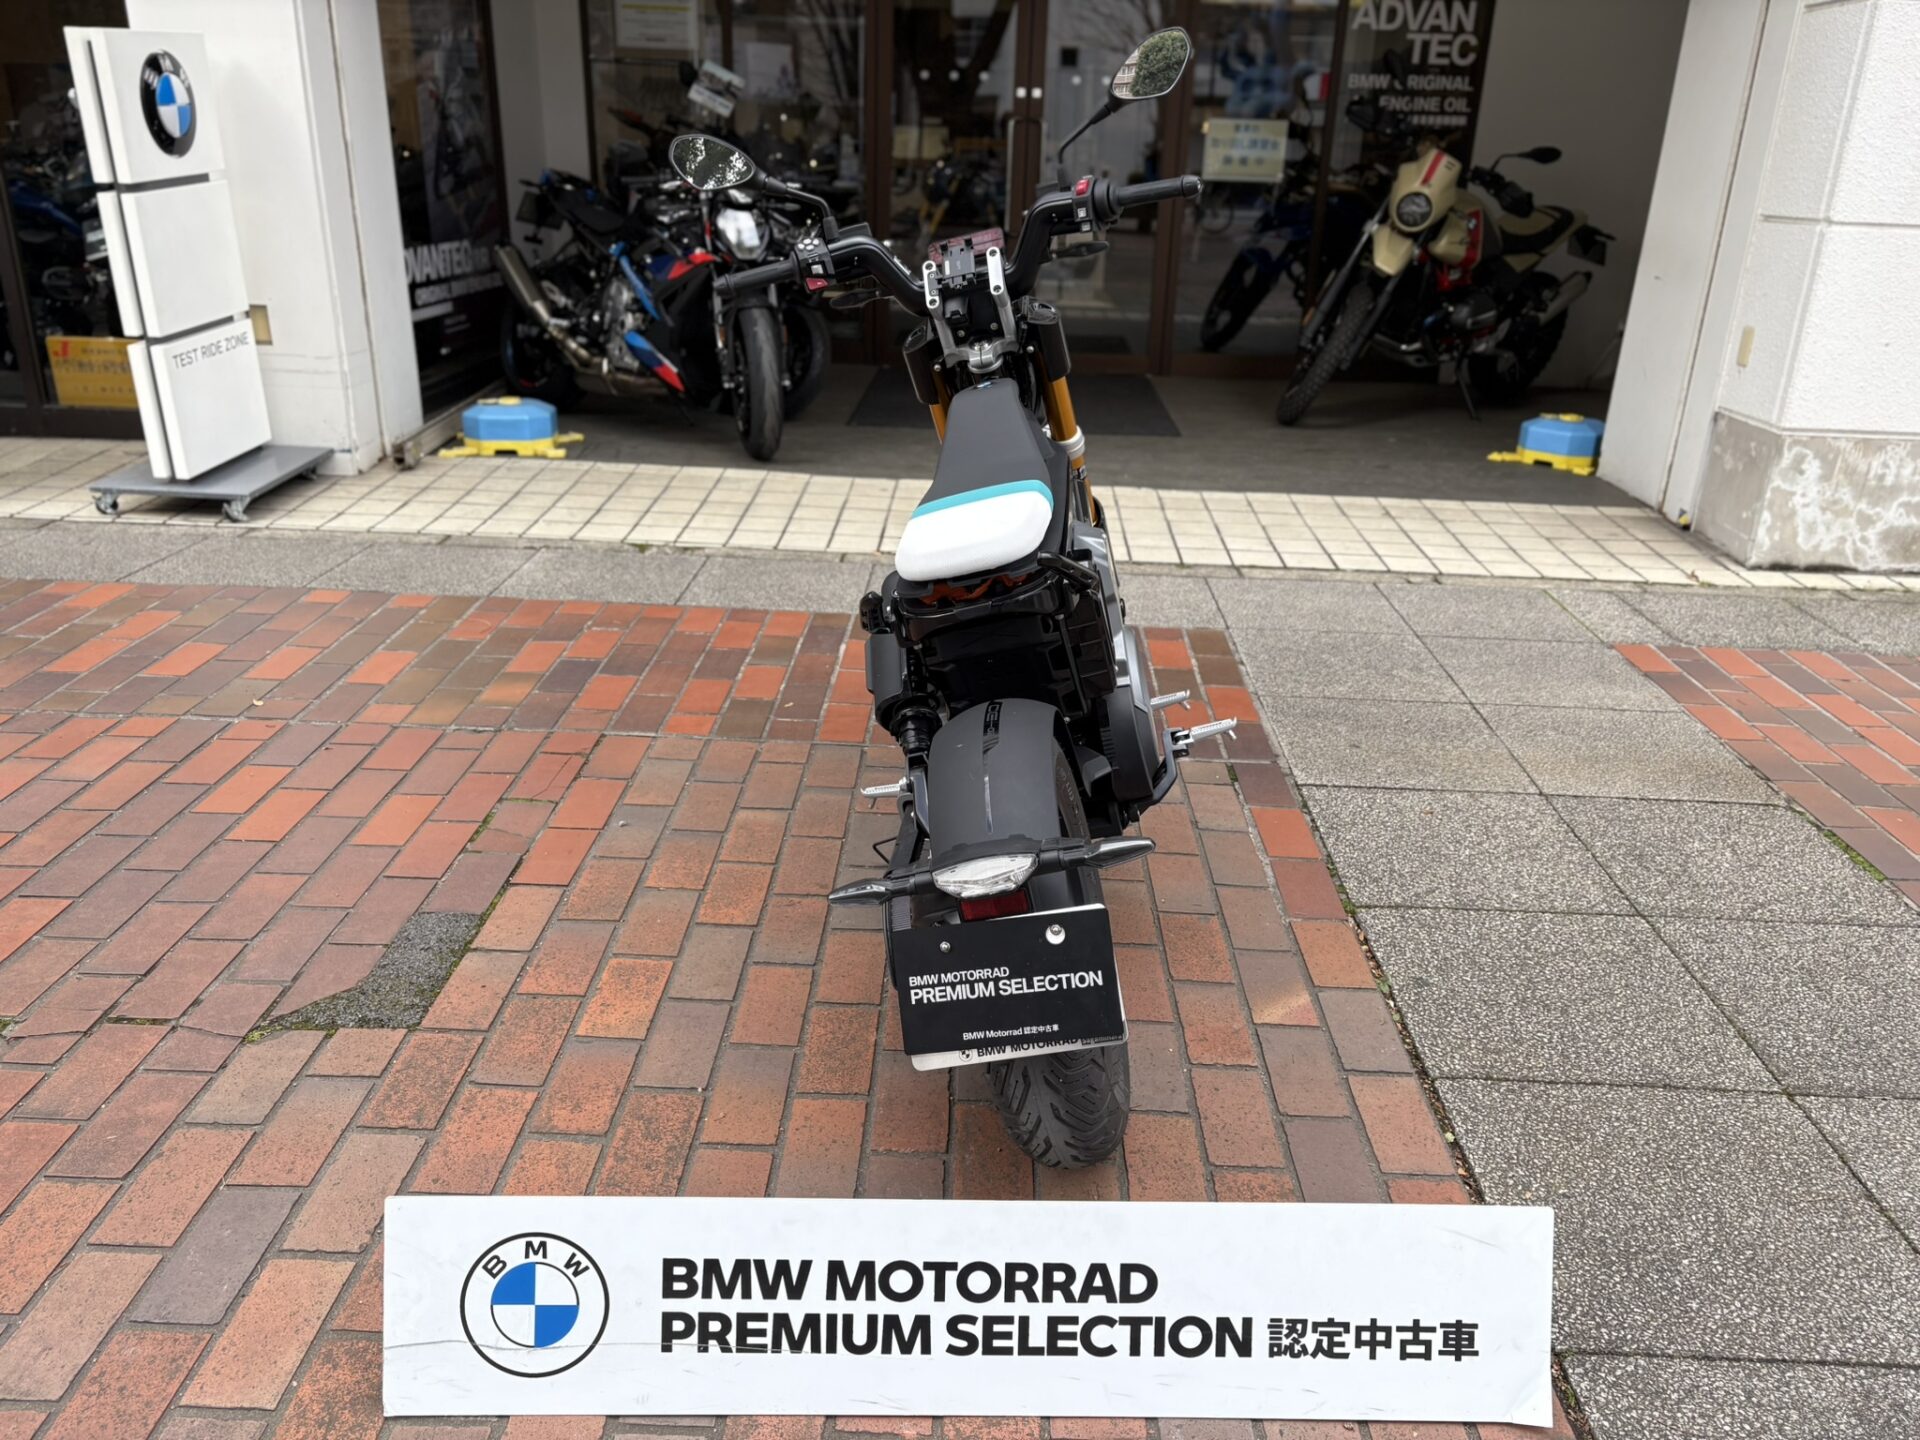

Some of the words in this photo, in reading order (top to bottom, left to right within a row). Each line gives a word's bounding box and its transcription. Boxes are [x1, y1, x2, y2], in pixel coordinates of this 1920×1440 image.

[1352, 0, 1477, 32] ADVAN
[1406, 32, 1479, 67] TEC
[1347, 73, 1391, 89] BMW
[1443, 96, 1472, 113] OIL
[172, 347, 198, 370] TEST
[200, 339, 223, 360] RIDE
[224, 330, 249, 352] ZONE
[908, 973, 939, 987] BMW
[940, 966, 1010, 984] MOTORRAD
[909, 981, 996, 1005] PREMIUM
[998, 970, 1104, 996] SELECTION
[963, 1030, 985, 1041] BMW
[986, 1026, 1023, 1039] Motorrad
[1023, 1023, 1060, 1035] 認定中古車
[482, 1240, 590, 1280] BMW
[662, 1257, 813, 1300] BMW
[825, 1260, 1158, 1304] MOTORRAD
[661, 1311, 932, 1356] PREMIUM
[944, 1314, 1253, 1358] SELECTION
[1267, 1317, 1480, 1362] 認定中古車
